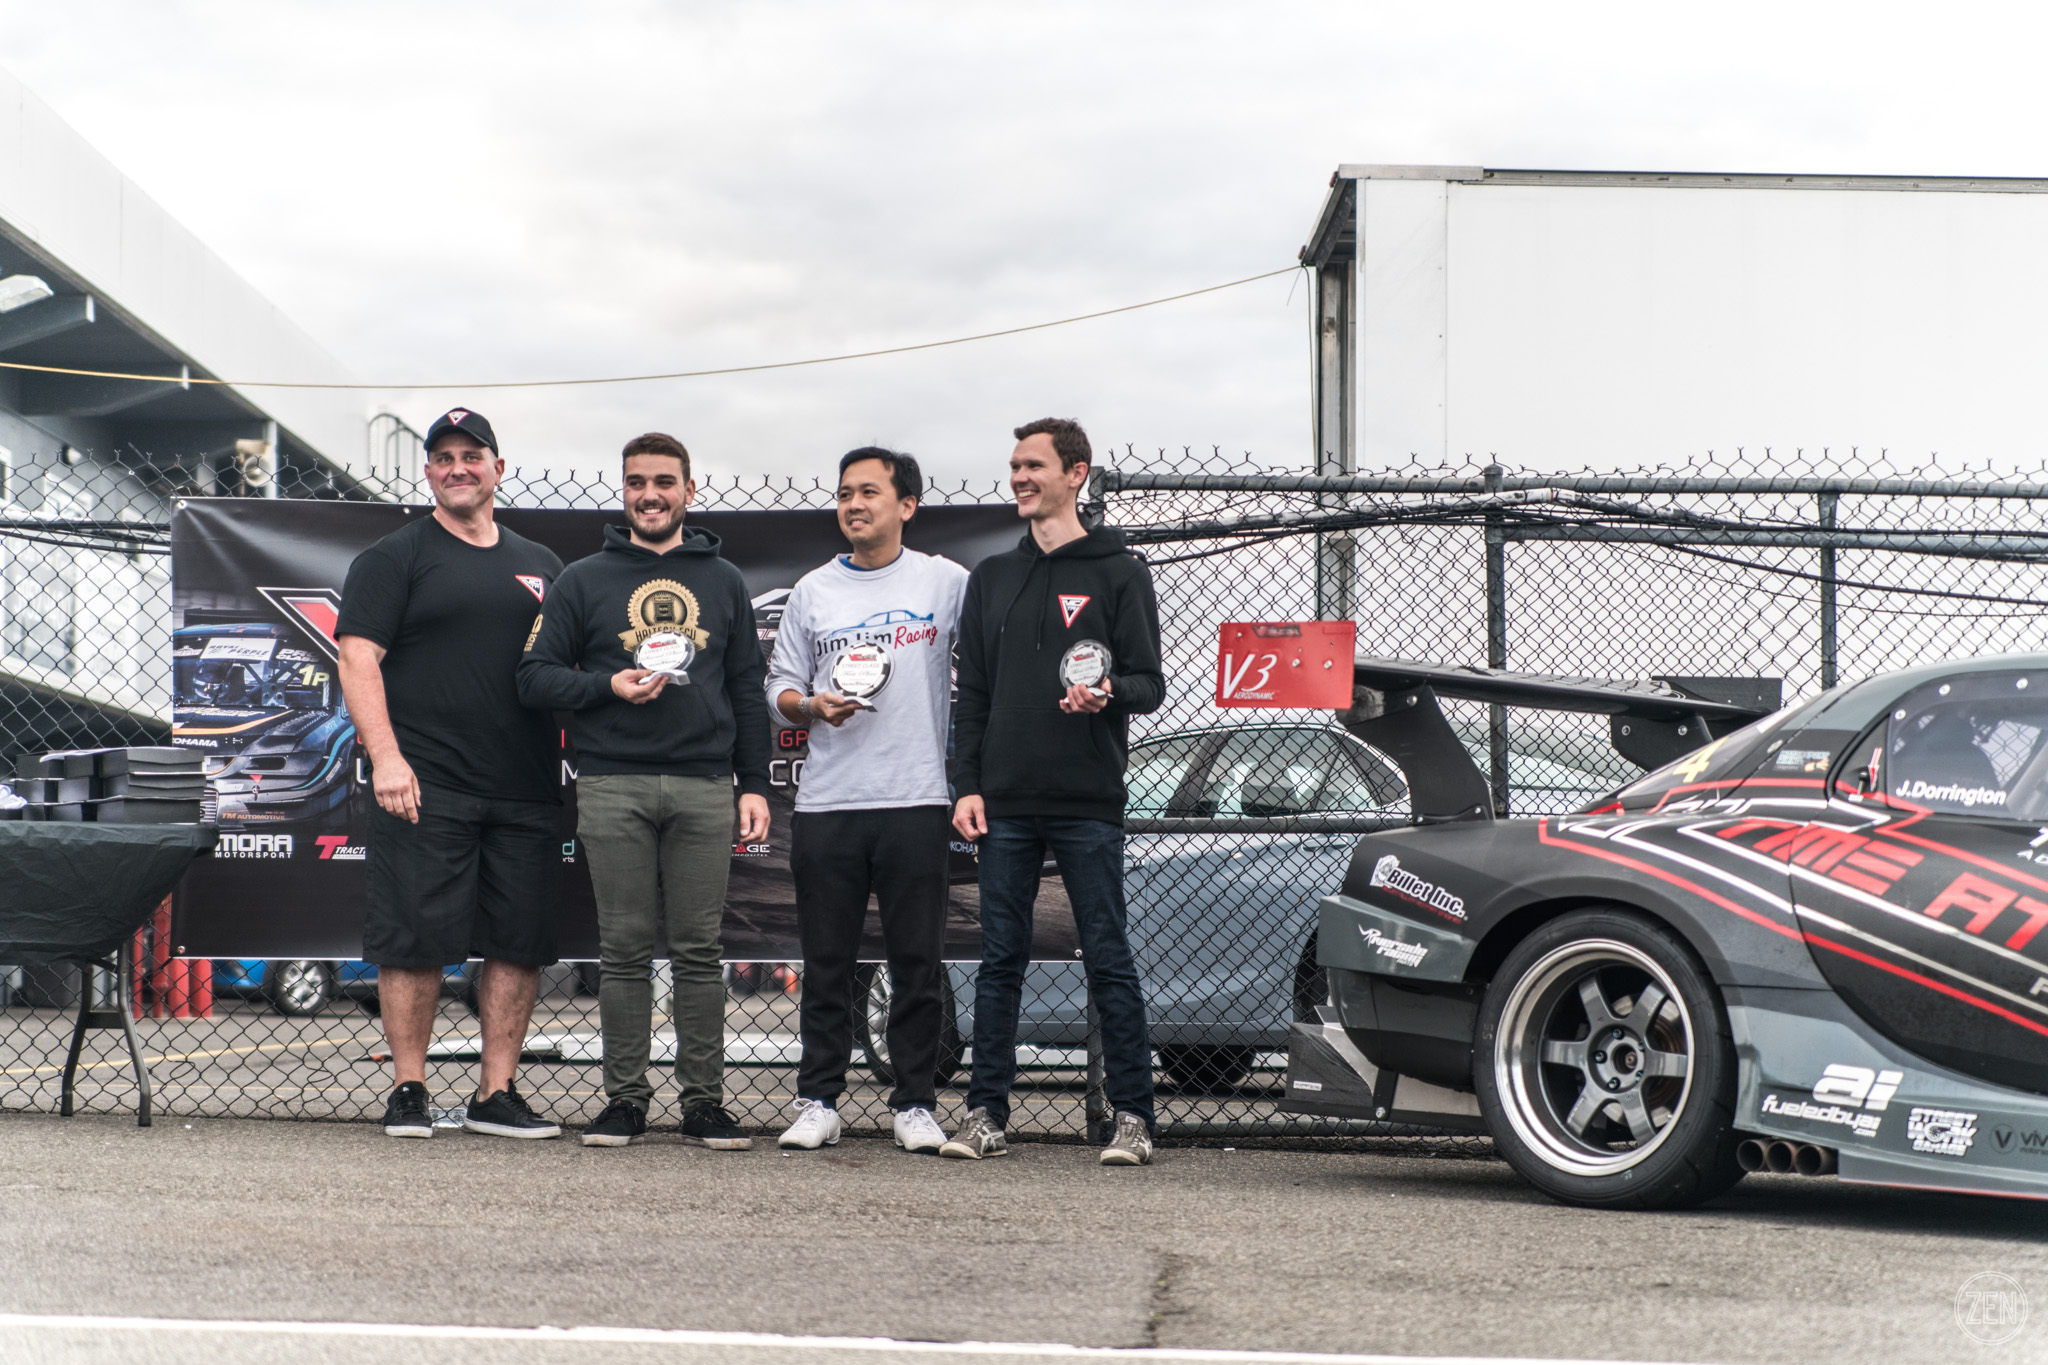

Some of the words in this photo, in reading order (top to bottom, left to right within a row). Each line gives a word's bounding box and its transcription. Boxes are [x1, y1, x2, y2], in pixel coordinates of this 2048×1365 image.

[632, 594, 644, 623] CUTTING
[643, 583, 662, 594] EDGE
[664, 583, 696, 622] TECHNOLOGY
[816, 637, 848, 657] Jim
[894, 623, 938, 649] Racing
[298, 664, 330, 687] 1P
[1222, 653, 1278, 699] V3
[1232, 691, 1276, 700] AERODYNAMIC
[1672, 736, 1730, 784] 4
[1895, 780, 2007, 806] J.Dorrington
[215, 851, 292, 859] MOTORSPORT
[335, 846, 365, 855] TRACT
[1385, 867, 1434, 902] Billet
[1429, 886, 1466, 919] Inc.
[1762, 1094, 1882, 1131] fueledbyai
[1909, 1107, 1978, 1127] STREET
